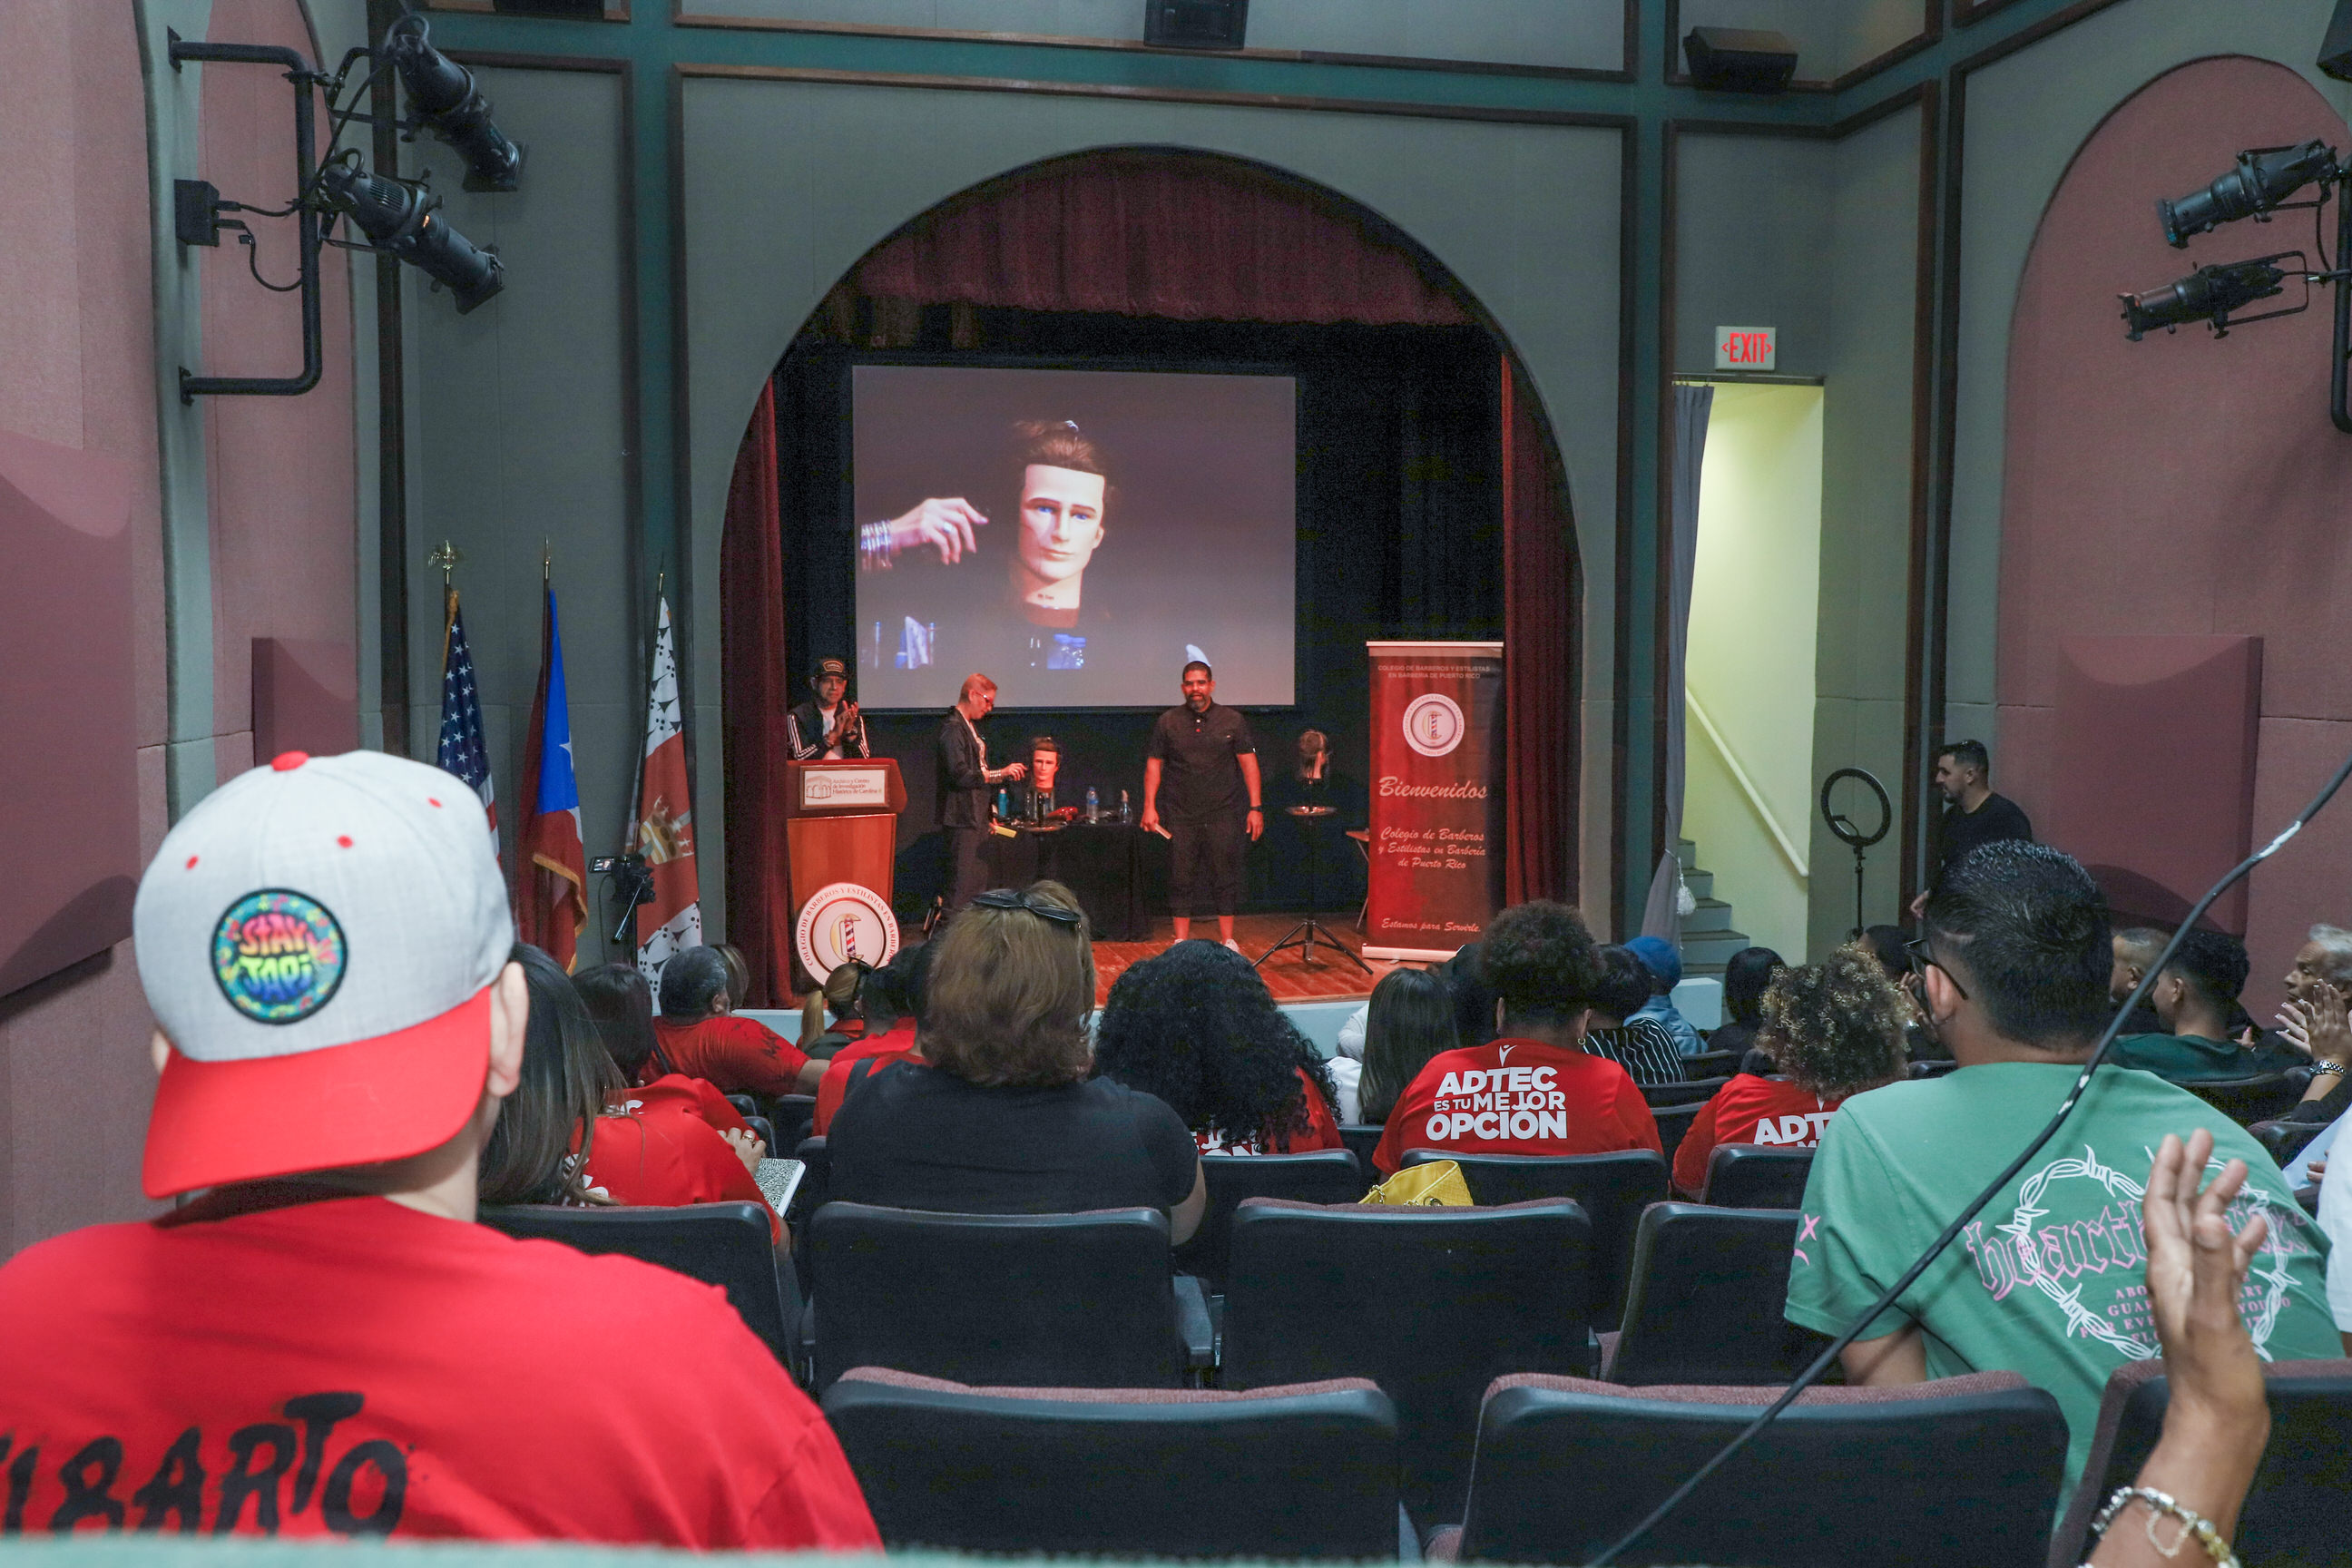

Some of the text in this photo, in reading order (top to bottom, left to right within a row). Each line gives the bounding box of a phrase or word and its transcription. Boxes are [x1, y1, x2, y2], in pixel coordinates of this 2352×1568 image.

[1730, 332, 1769, 363] EXIT
[1378, 776, 1487, 799] Bienvenidos
[1380, 827, 1485, 842] Colegio de Barberos
[1377, 845, 1384, 855] y
[1387, 842, 1431, 854] Estilistas
[1397, 857, 1466, 869] de Puerto Rico
[806, 889, 839, 916] BARBEROS
[847, 887, 885, 913] ESTILISTAS
[238, 913, 309, 956] STAY
[800, 918, 809, 928] DE
[1381, 917, 1417, 929] Estamos
[1419, 922, 1441, 931] para
[799, 930, 814, 966] COLEGIO
[1435, 1065, 1558, 1098] ADTEC
[1434, 1091, 1566, 1112] ES TU MEJOR
[1753, 1111, 1838, 1145] ADT
